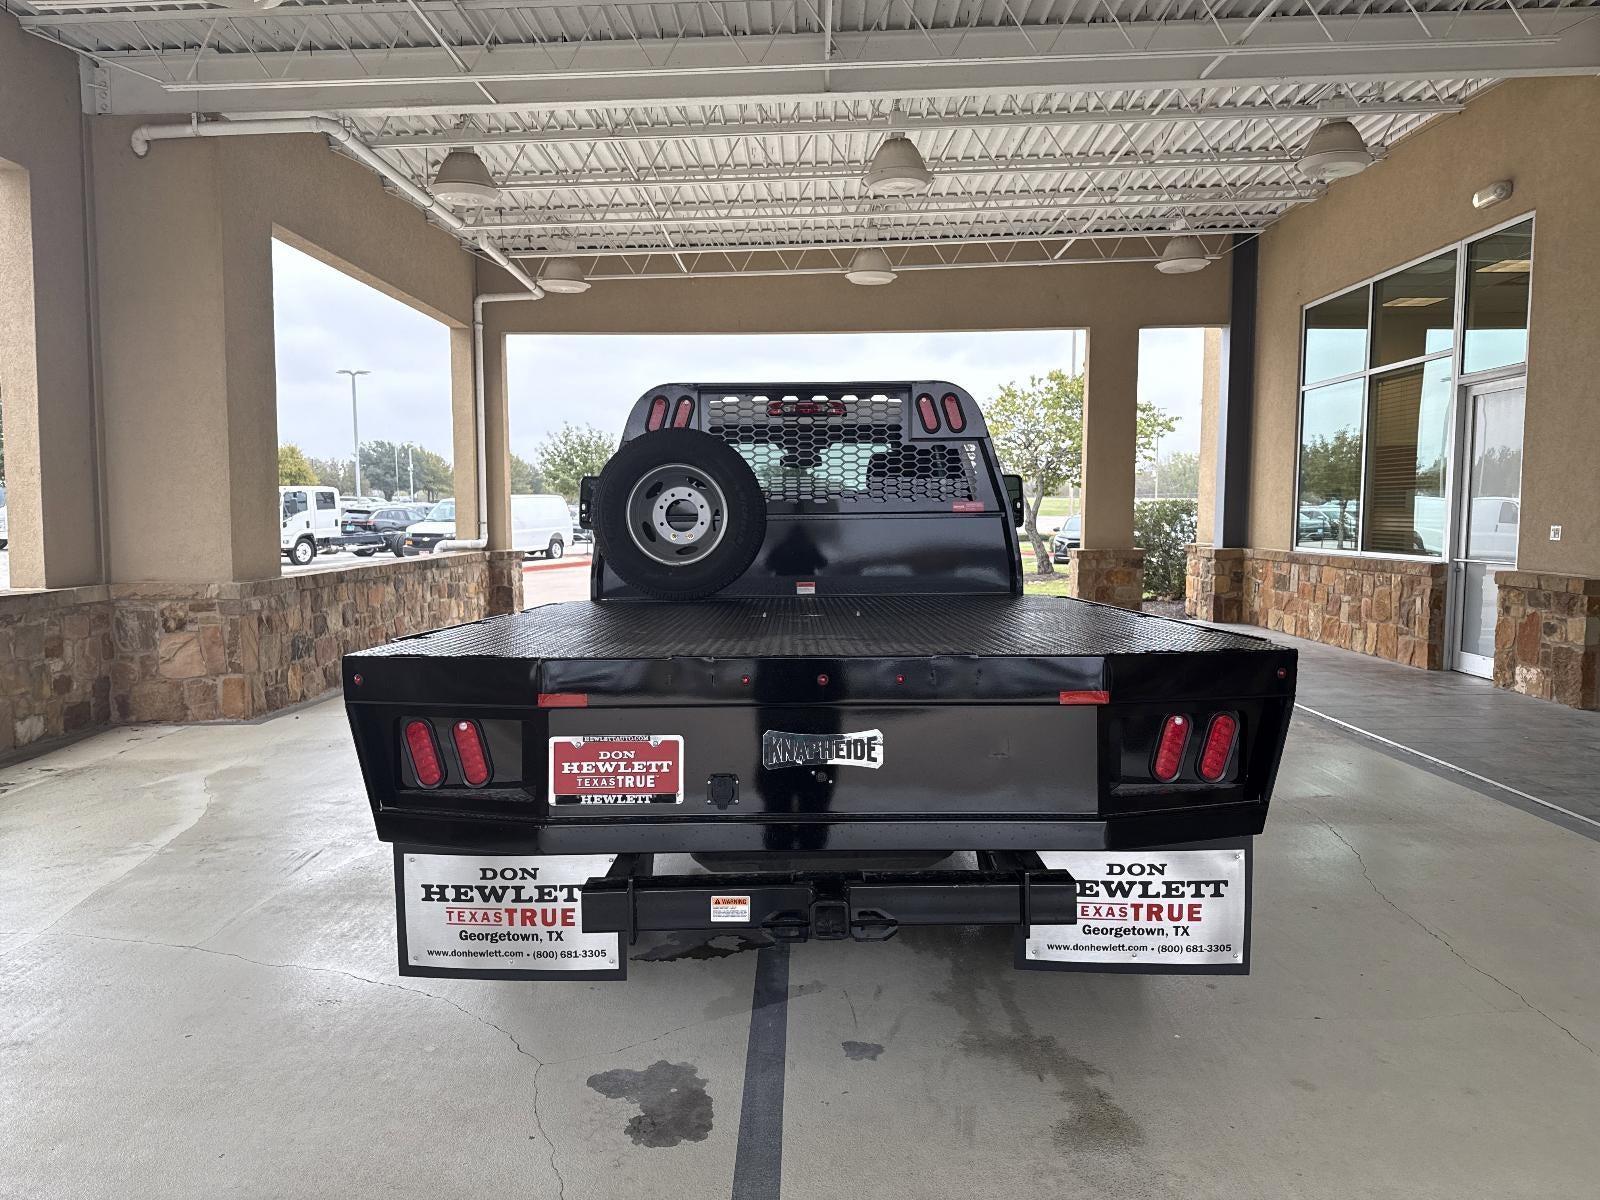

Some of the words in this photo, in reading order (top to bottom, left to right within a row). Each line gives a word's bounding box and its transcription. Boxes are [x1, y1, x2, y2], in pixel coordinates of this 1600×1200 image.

[599, 751, 635, 760] DON
[767, 735, 878, 764] KNAPHEIDE
[561, 761, 673, 774] HEWLETT
[580, 794, 653, 804] HEWLETT
[479, 867, 540, 881] DON
[1106, 863, 1168, 876] DON
[420, 883, 584, 903] HEWLET
[1075, 879, 1229, 899] EWLETT
[1080, 905, 1128, 919] EXAS
[458, 930, 543, 944] Georgetown,
[546, 930, 565, 942] TX
[1082, 924, 1169, 938] Georgetown,
[1173, 926, 1191, 937] TX
[427, 949, 524, 958] www.donhewlett.com
[532, 950, 558, 960] (800)
[560, 949, 607, 959] 681-3305
[1046, 943, 1148, 952] www.donhewlett.com
[1157, 944, 1183, 955] (800)
[1185, 944, 1232, 953] 681-3305
